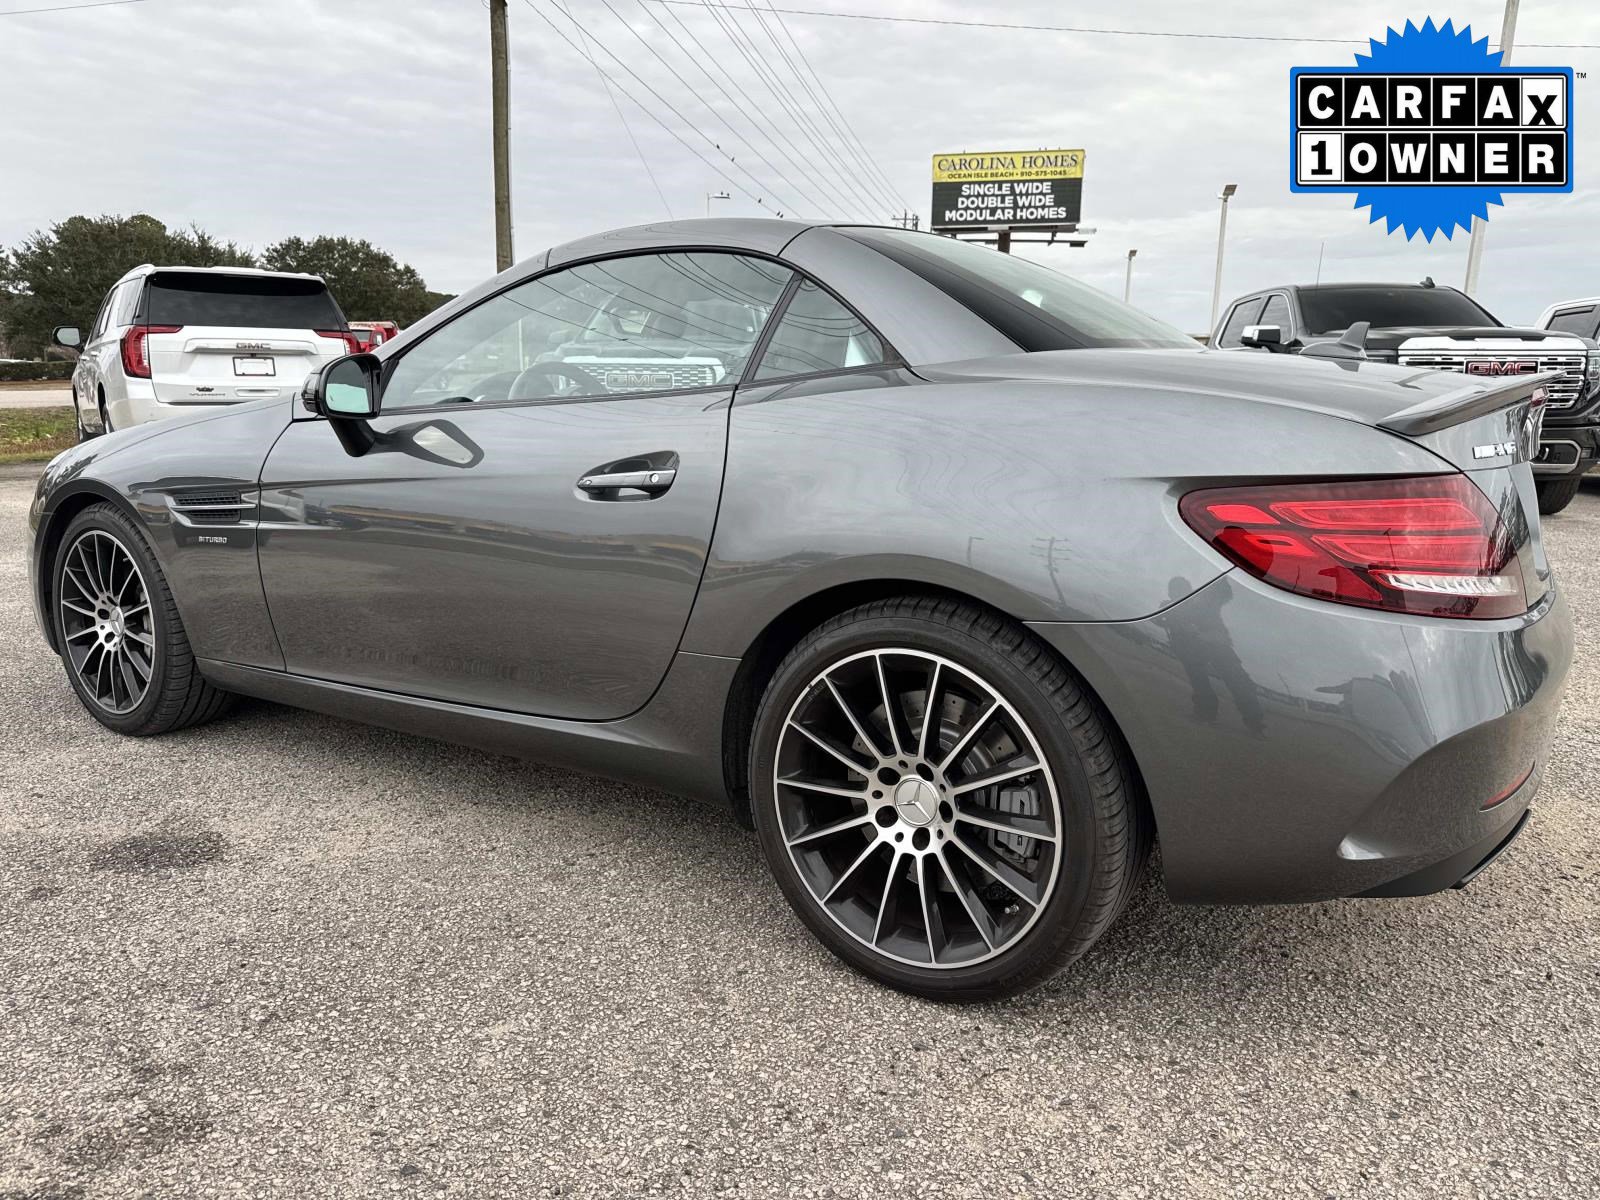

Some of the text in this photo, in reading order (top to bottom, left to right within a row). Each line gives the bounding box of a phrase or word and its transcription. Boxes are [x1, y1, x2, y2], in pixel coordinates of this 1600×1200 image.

[937, 153, 1078, 172] CAROLINA HOMES
[947, 172, 973, 180] OCEAN
[961, 182, 1052, 195] SINGLE WIDE
[957, 194, 1055, 209] DOUBLE WIDE
[945, 207, 1067, 222] MODULAR HOMES
[236, 342, 271, 350] GMC
[1468, 361, 1536, 375] GMC
[608, 374, 672, 387] GMC
[198, 536, 227, 544] BITURBO
